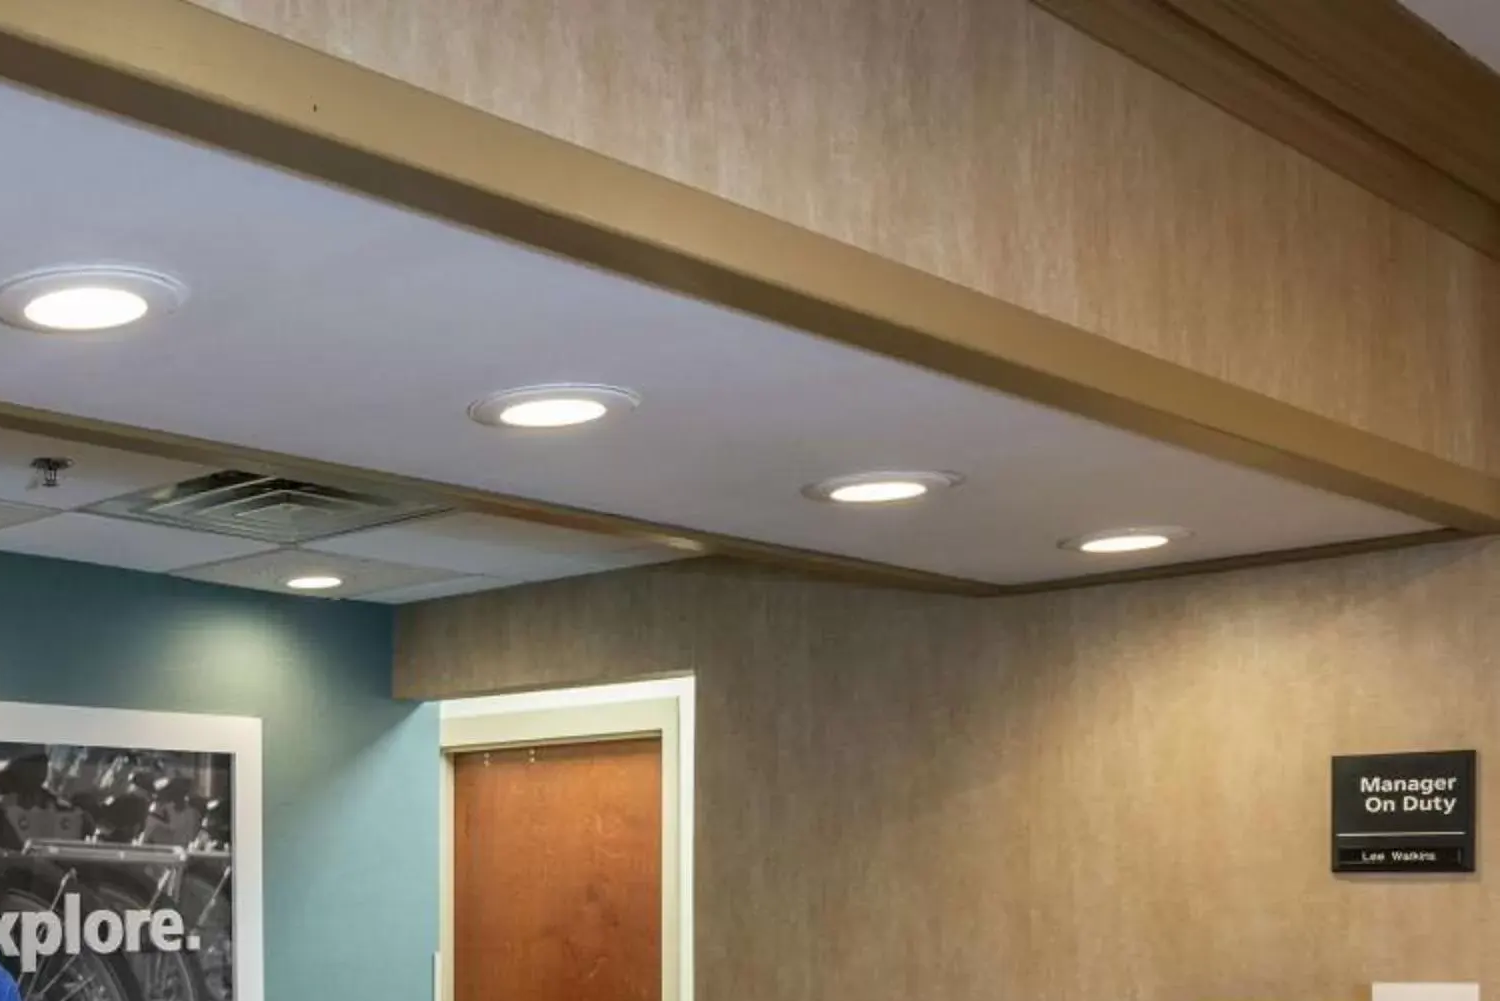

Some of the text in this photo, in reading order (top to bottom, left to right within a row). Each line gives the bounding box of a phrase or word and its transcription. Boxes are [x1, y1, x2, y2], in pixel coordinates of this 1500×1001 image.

[1360, 776, 1457, 795] Manager
[1365, 795, 1457, 815] On Duty
